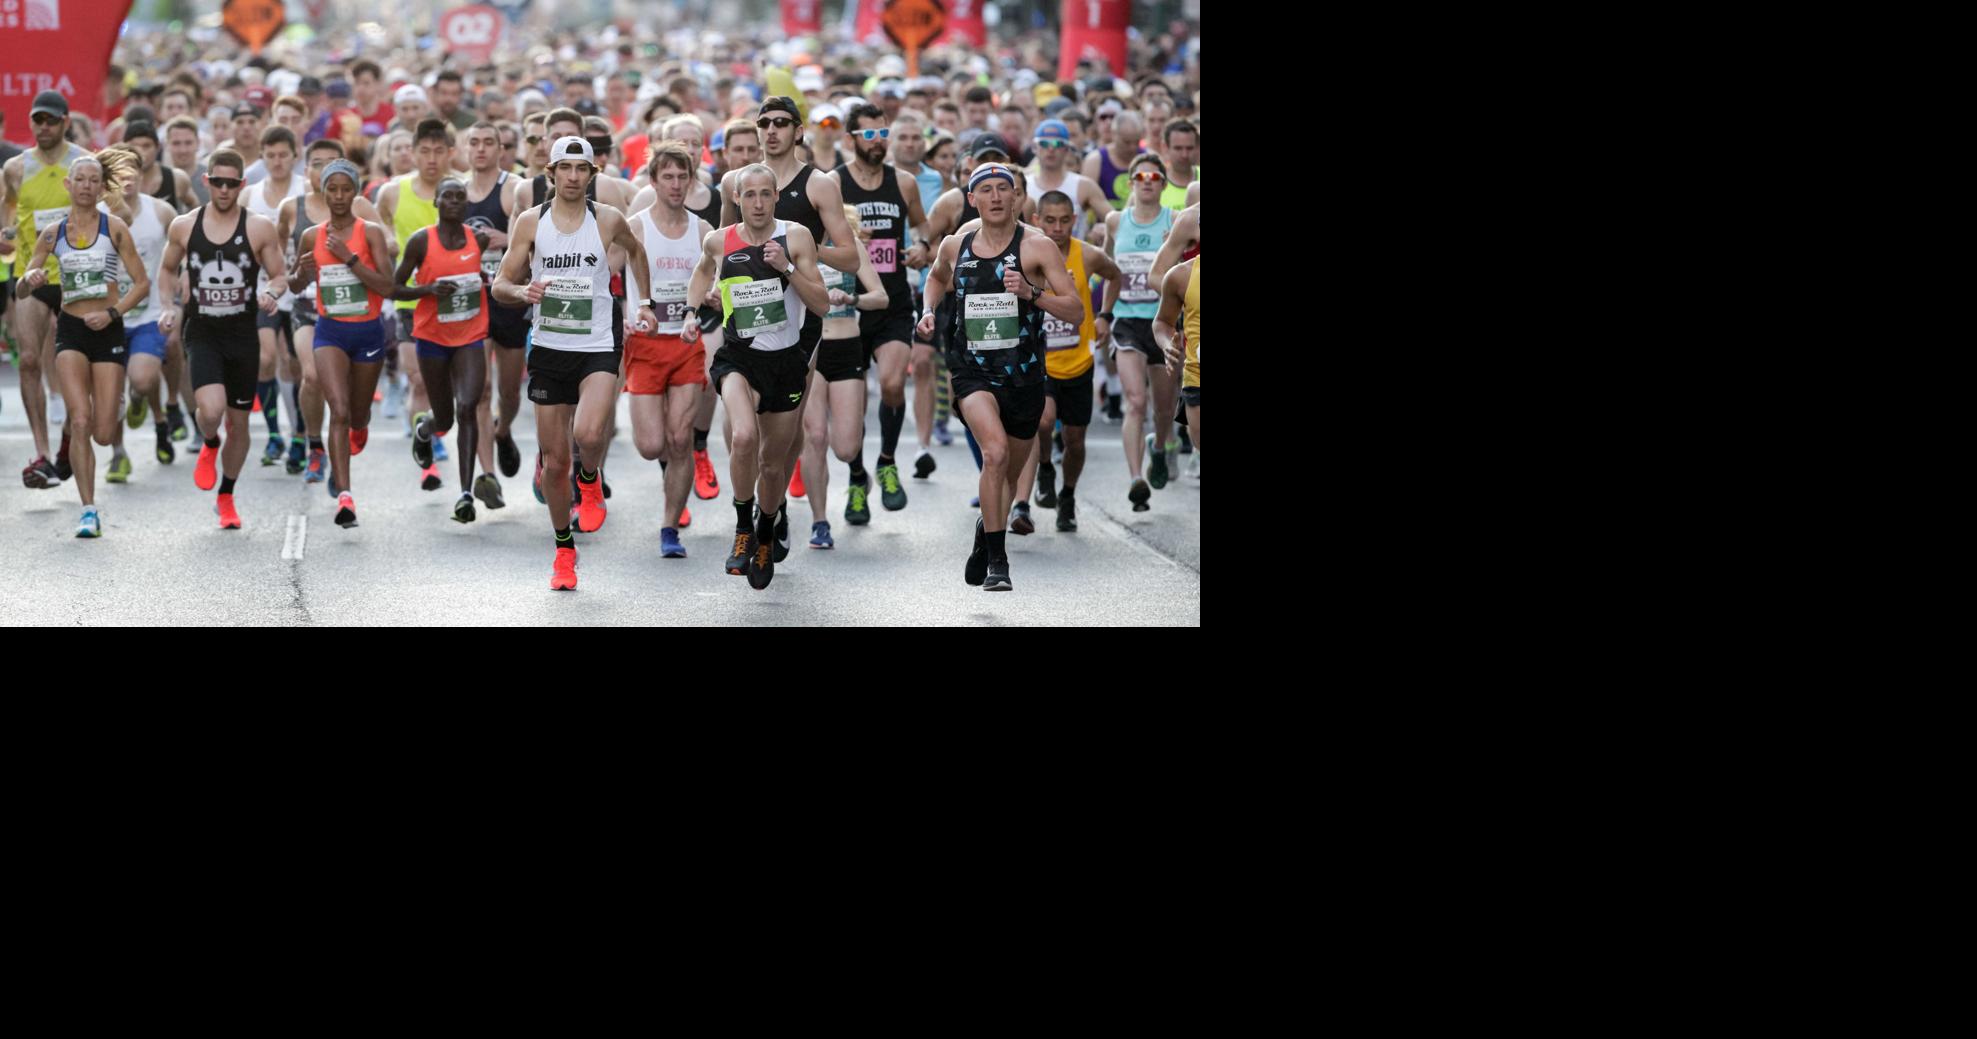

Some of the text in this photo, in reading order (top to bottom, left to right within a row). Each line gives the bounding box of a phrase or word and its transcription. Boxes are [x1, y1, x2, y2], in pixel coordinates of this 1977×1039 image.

[874, 202, 900, 218] TEXAS
[542, 253, 581, 268] rabbit
[74, 272, 89, 284] 61
[335, 286, 350, 298] 51
[761, 285, 779, 293] Roll
[204, 289, 240, 302] 1035
[452, 296, 468, 307] 52
[561, 301, 571, 313] 7
[754, 306, 765, 320] 2
[986, 320, 997, 333] 4
